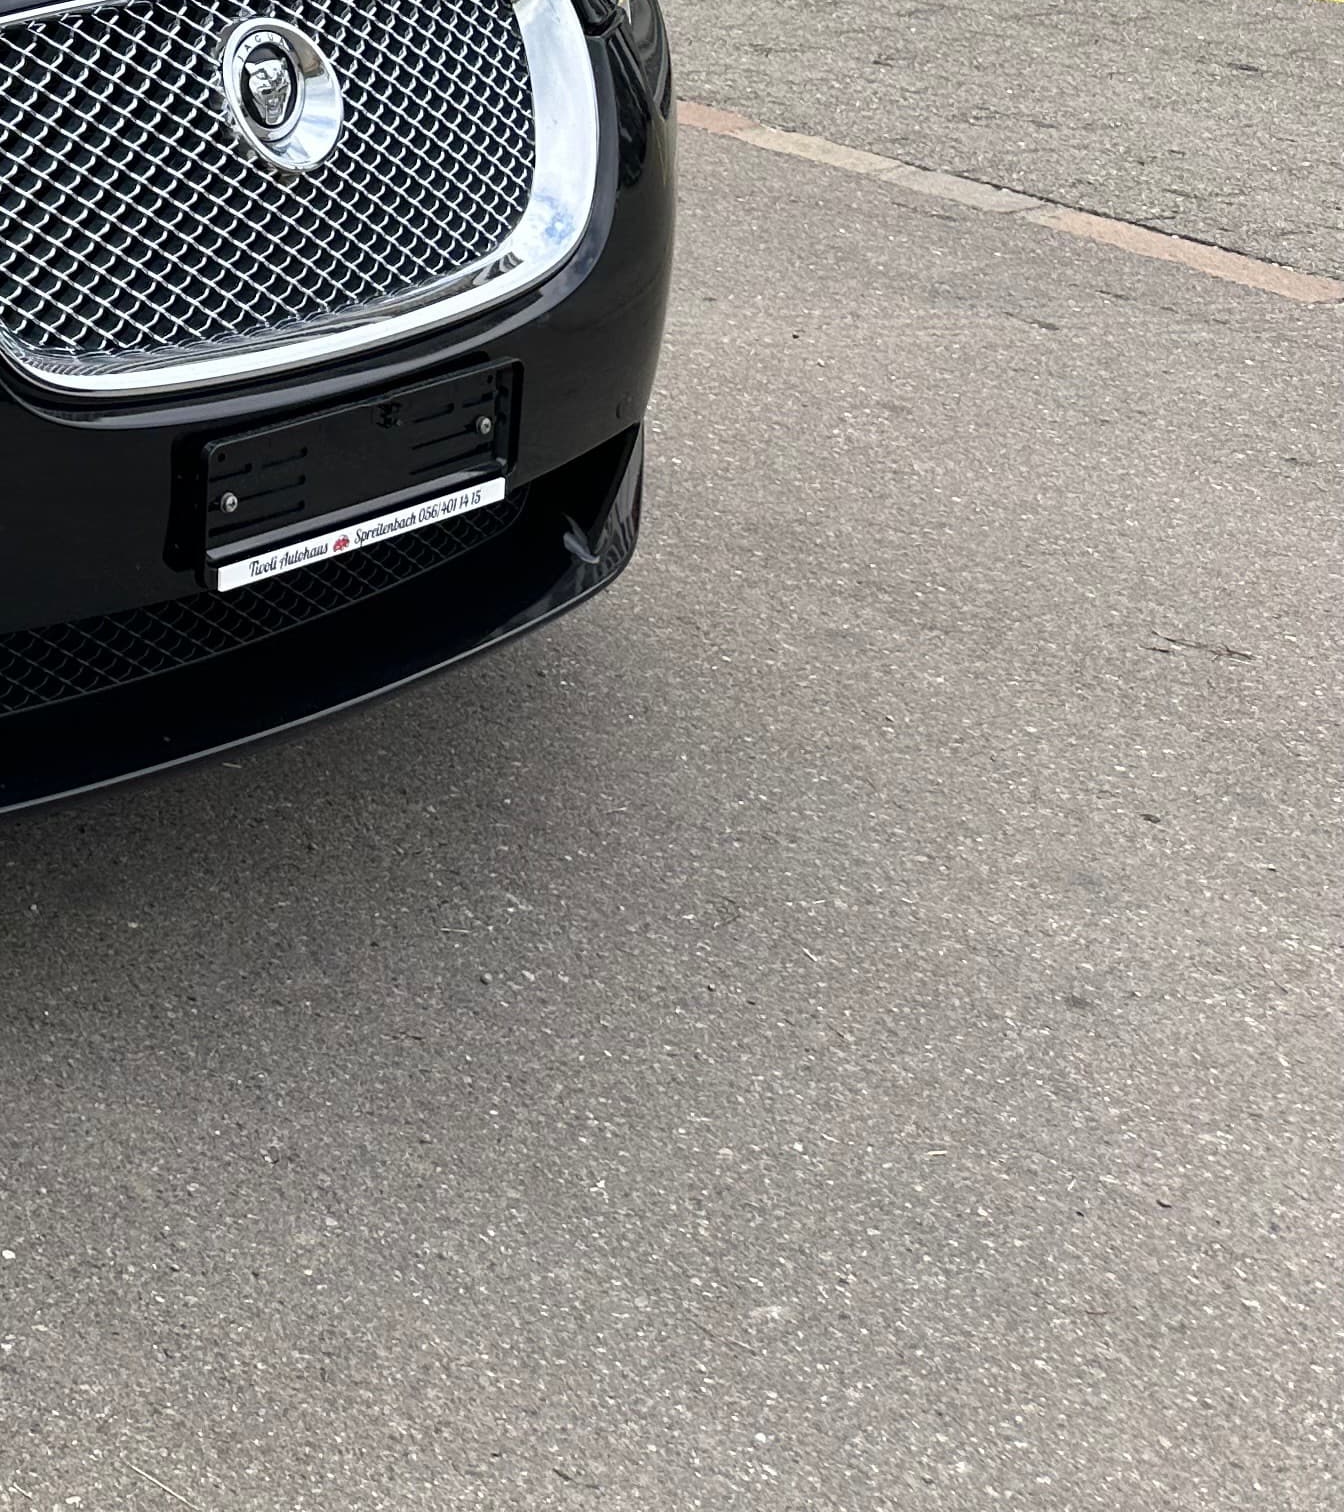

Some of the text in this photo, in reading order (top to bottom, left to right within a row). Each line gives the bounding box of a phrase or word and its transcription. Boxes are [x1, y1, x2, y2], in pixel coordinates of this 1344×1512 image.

[249, 555, 277, 577] Tivoli
[279, 541, 328, 569] Autohaus
[418, 500, 457, 524] 056/401
[459, 494, 469, 512] 14
[471, 489, 481, 506] 15
